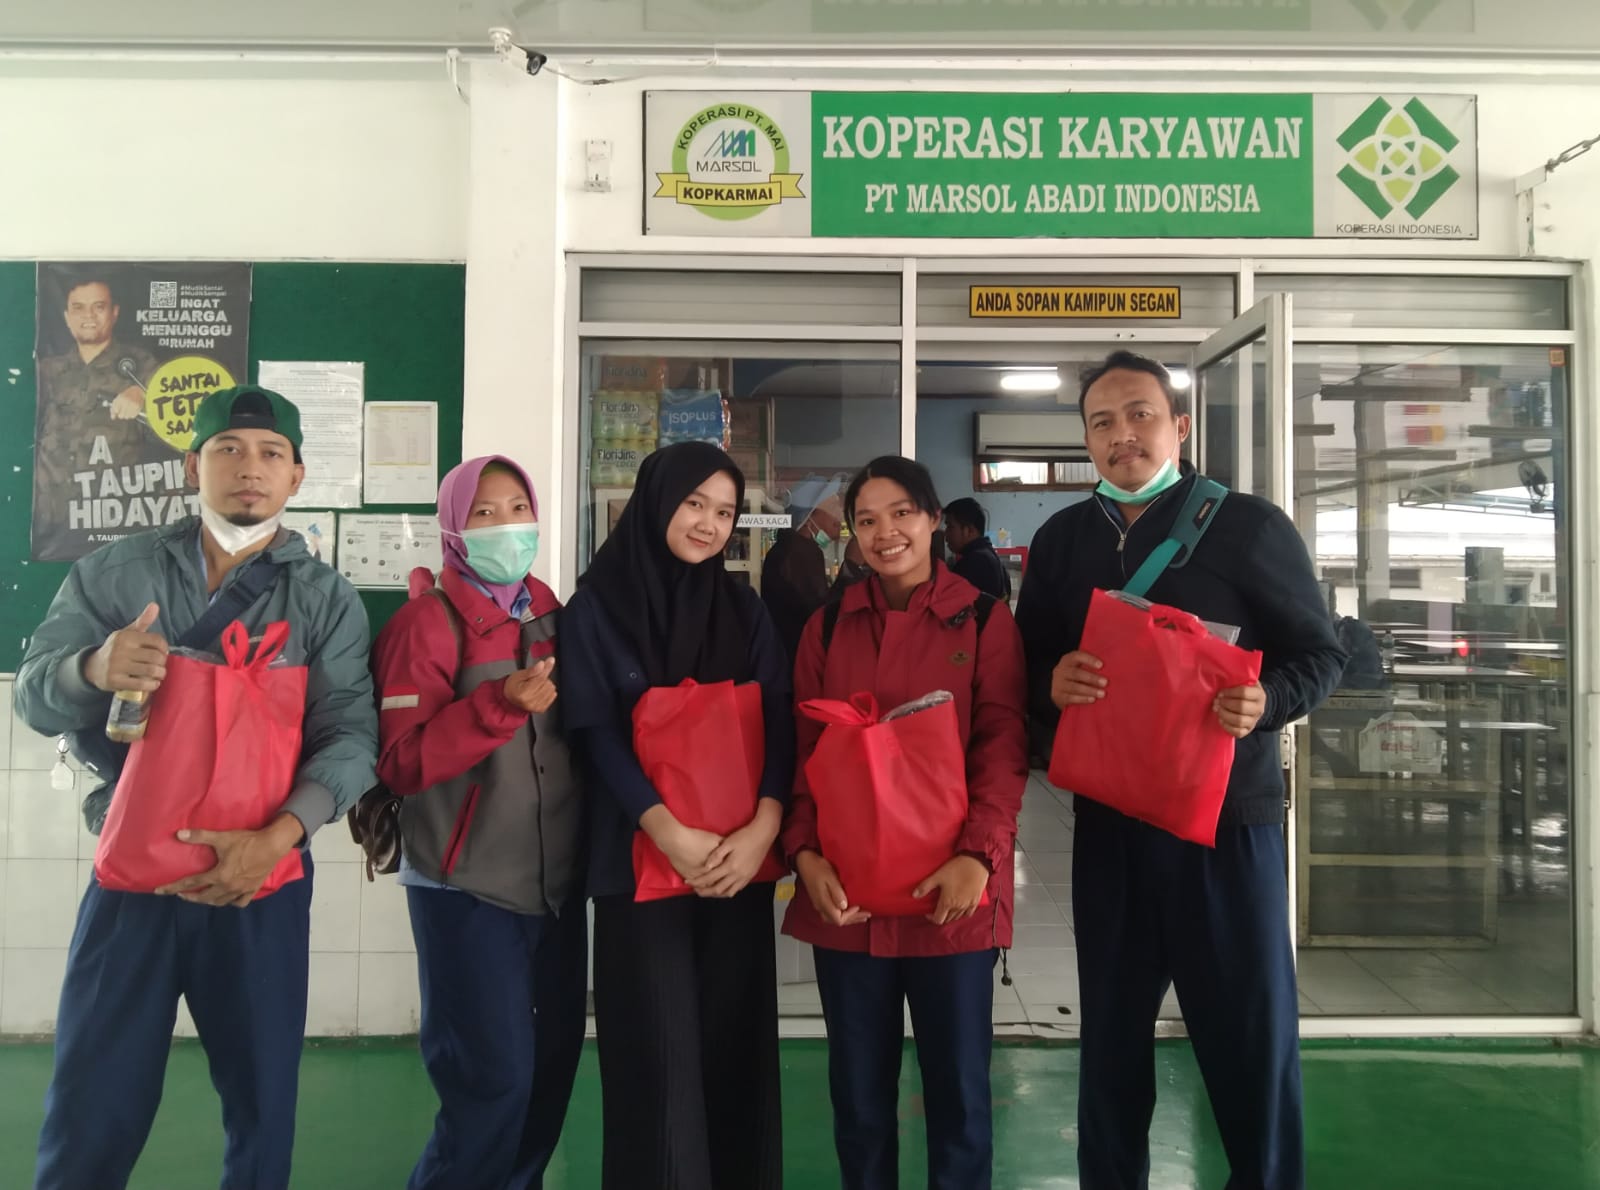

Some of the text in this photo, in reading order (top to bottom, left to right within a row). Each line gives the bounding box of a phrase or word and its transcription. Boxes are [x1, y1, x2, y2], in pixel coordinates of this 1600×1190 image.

[678, 106, 741, 150] KOPERASI
[764, 125, 785, 151] MAI
[822, 115, 1303, 160] KOPERASI KARYAWAN
[696, 160, 762, 172] MARSOL
[683, 187, 773, 201] KOPKARMAI
[864, 183, 1261, 213] PT MARSOL ABADI INDONESIA
[1336, 223, 1462, 235] KOPERASI INDONESIA
[180, 299, 221, 308] INGAT
[976, 291, 1175, 313] ANDA SOPAN KAMIPUN SEGAN
[136, 309, 228, 322] KELUARGA
[142, 324, 232, 336] MENUNGGU
[159, 338, 214, 348] DI RUMAH
[160, 372, 220, 393] SANTAI
[152, 391, 209, 420] TET
[669, 410, 717, 425] ISOPLUS
[89, 435, 113, 465] A
[69, 495, 201, 530] HIDAYAT
[739, 517, 789, 526] AWAS KACA
